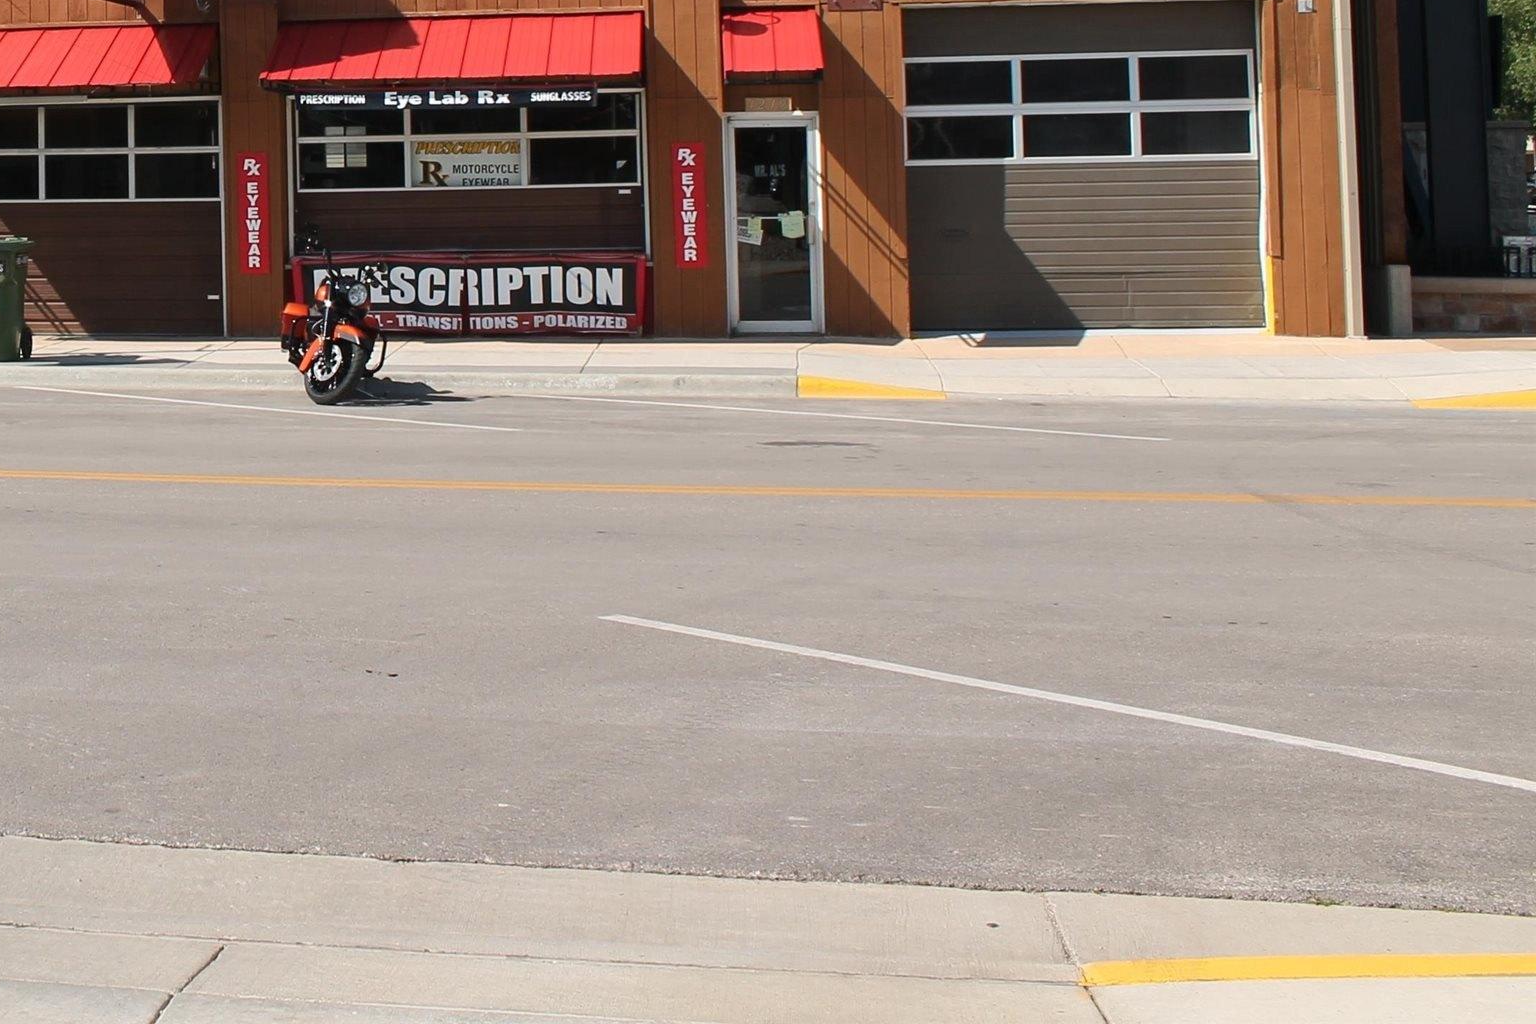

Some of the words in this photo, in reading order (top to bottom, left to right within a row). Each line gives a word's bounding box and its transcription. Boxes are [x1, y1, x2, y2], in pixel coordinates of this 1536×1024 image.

[300, 94, 365, 105] PRESCRIPTION
[384, 91, 422, 109] Eye
[429, 91, 469, 106] Lab
[478, 90, 511, 105] Rx
[531, 91, 592, 102] SUNGLASSES
[415, 141, 521, 155] PRESCRIPTION
[452, 163, 520, 174] MOTORCYCLE
[246, 182, 261, 268] EYEWEAR
[680, 173, 698, 262] EYEWEAR
[533, 314, 627, 329] POLARIZED
